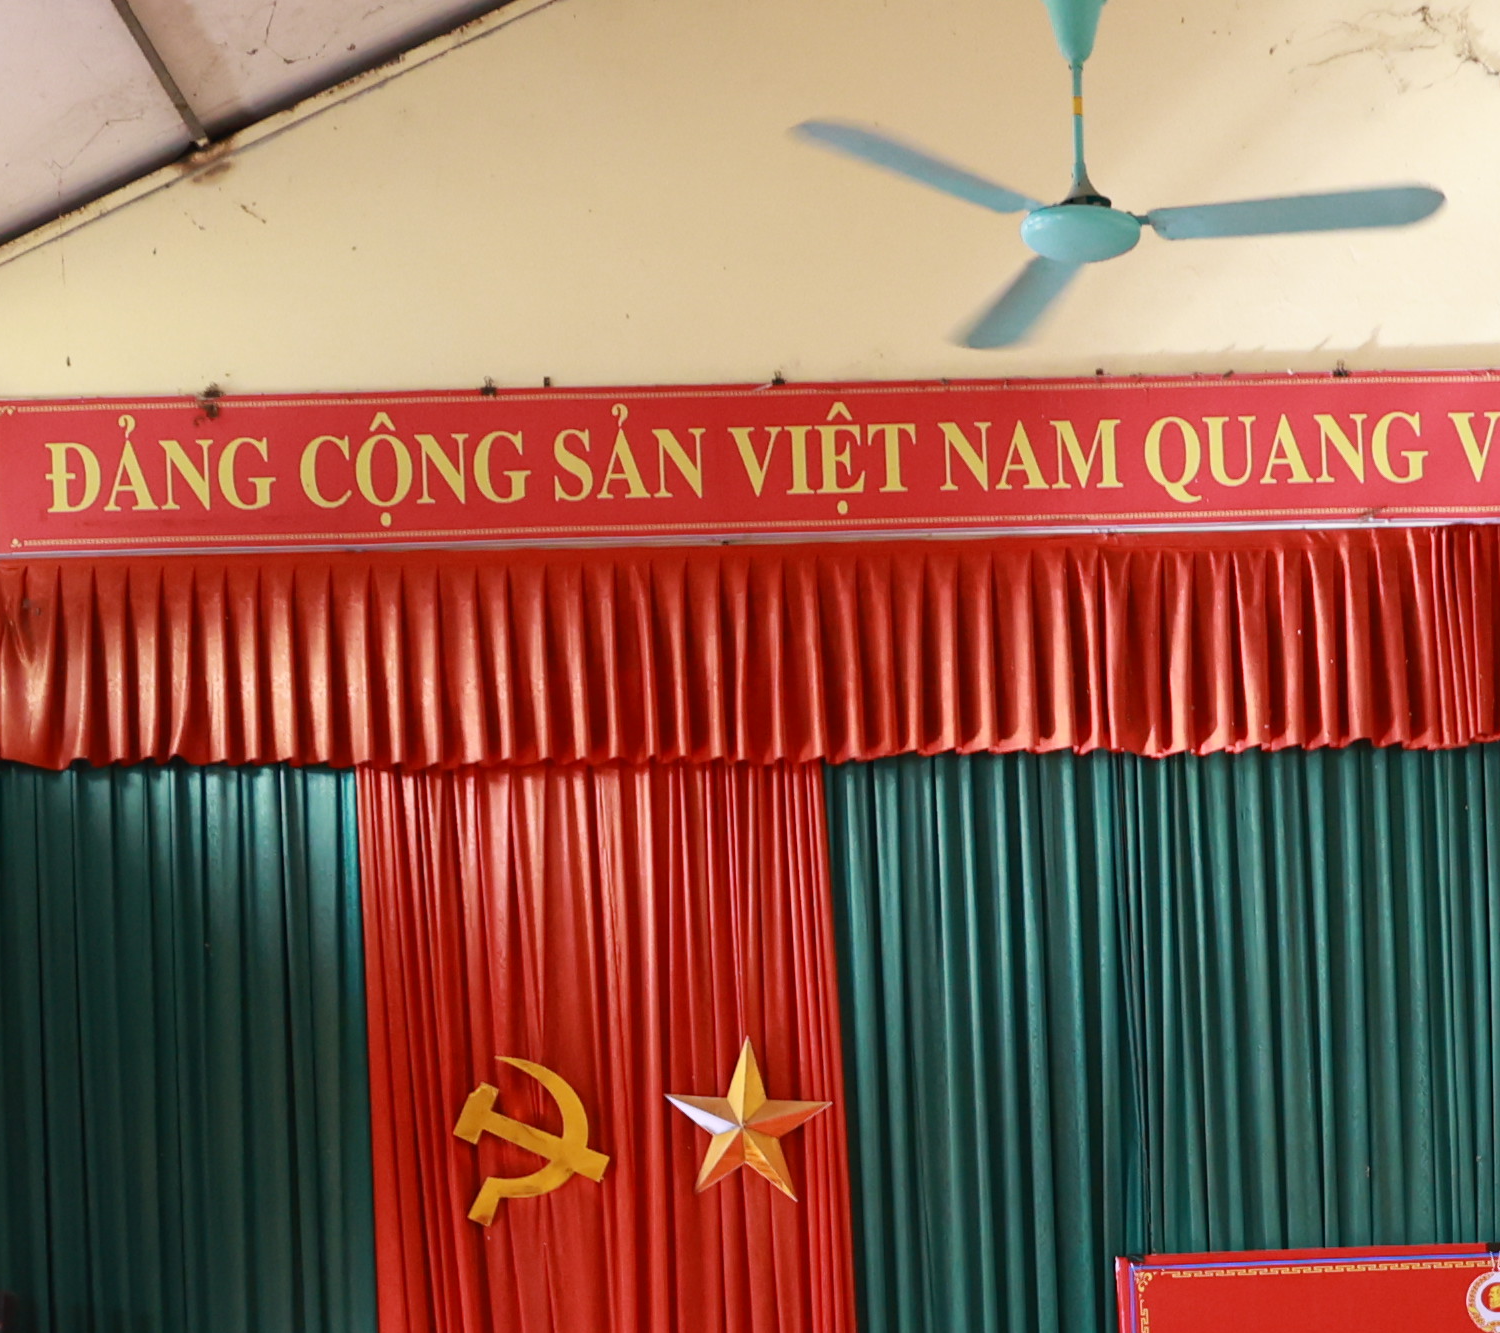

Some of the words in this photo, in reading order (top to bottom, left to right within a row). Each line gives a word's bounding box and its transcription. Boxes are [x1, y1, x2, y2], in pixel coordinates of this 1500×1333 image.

[43, 414, 277, 512] ĐẢNG
[299, 411, 532, 526] CỘNG
[553, 402, 707, 501] SẢN
[727, 421, 916, 515] VIỆT
[937, 419, 1123, 491] NAM
[1144, 411, 1428, 502] QUANG
